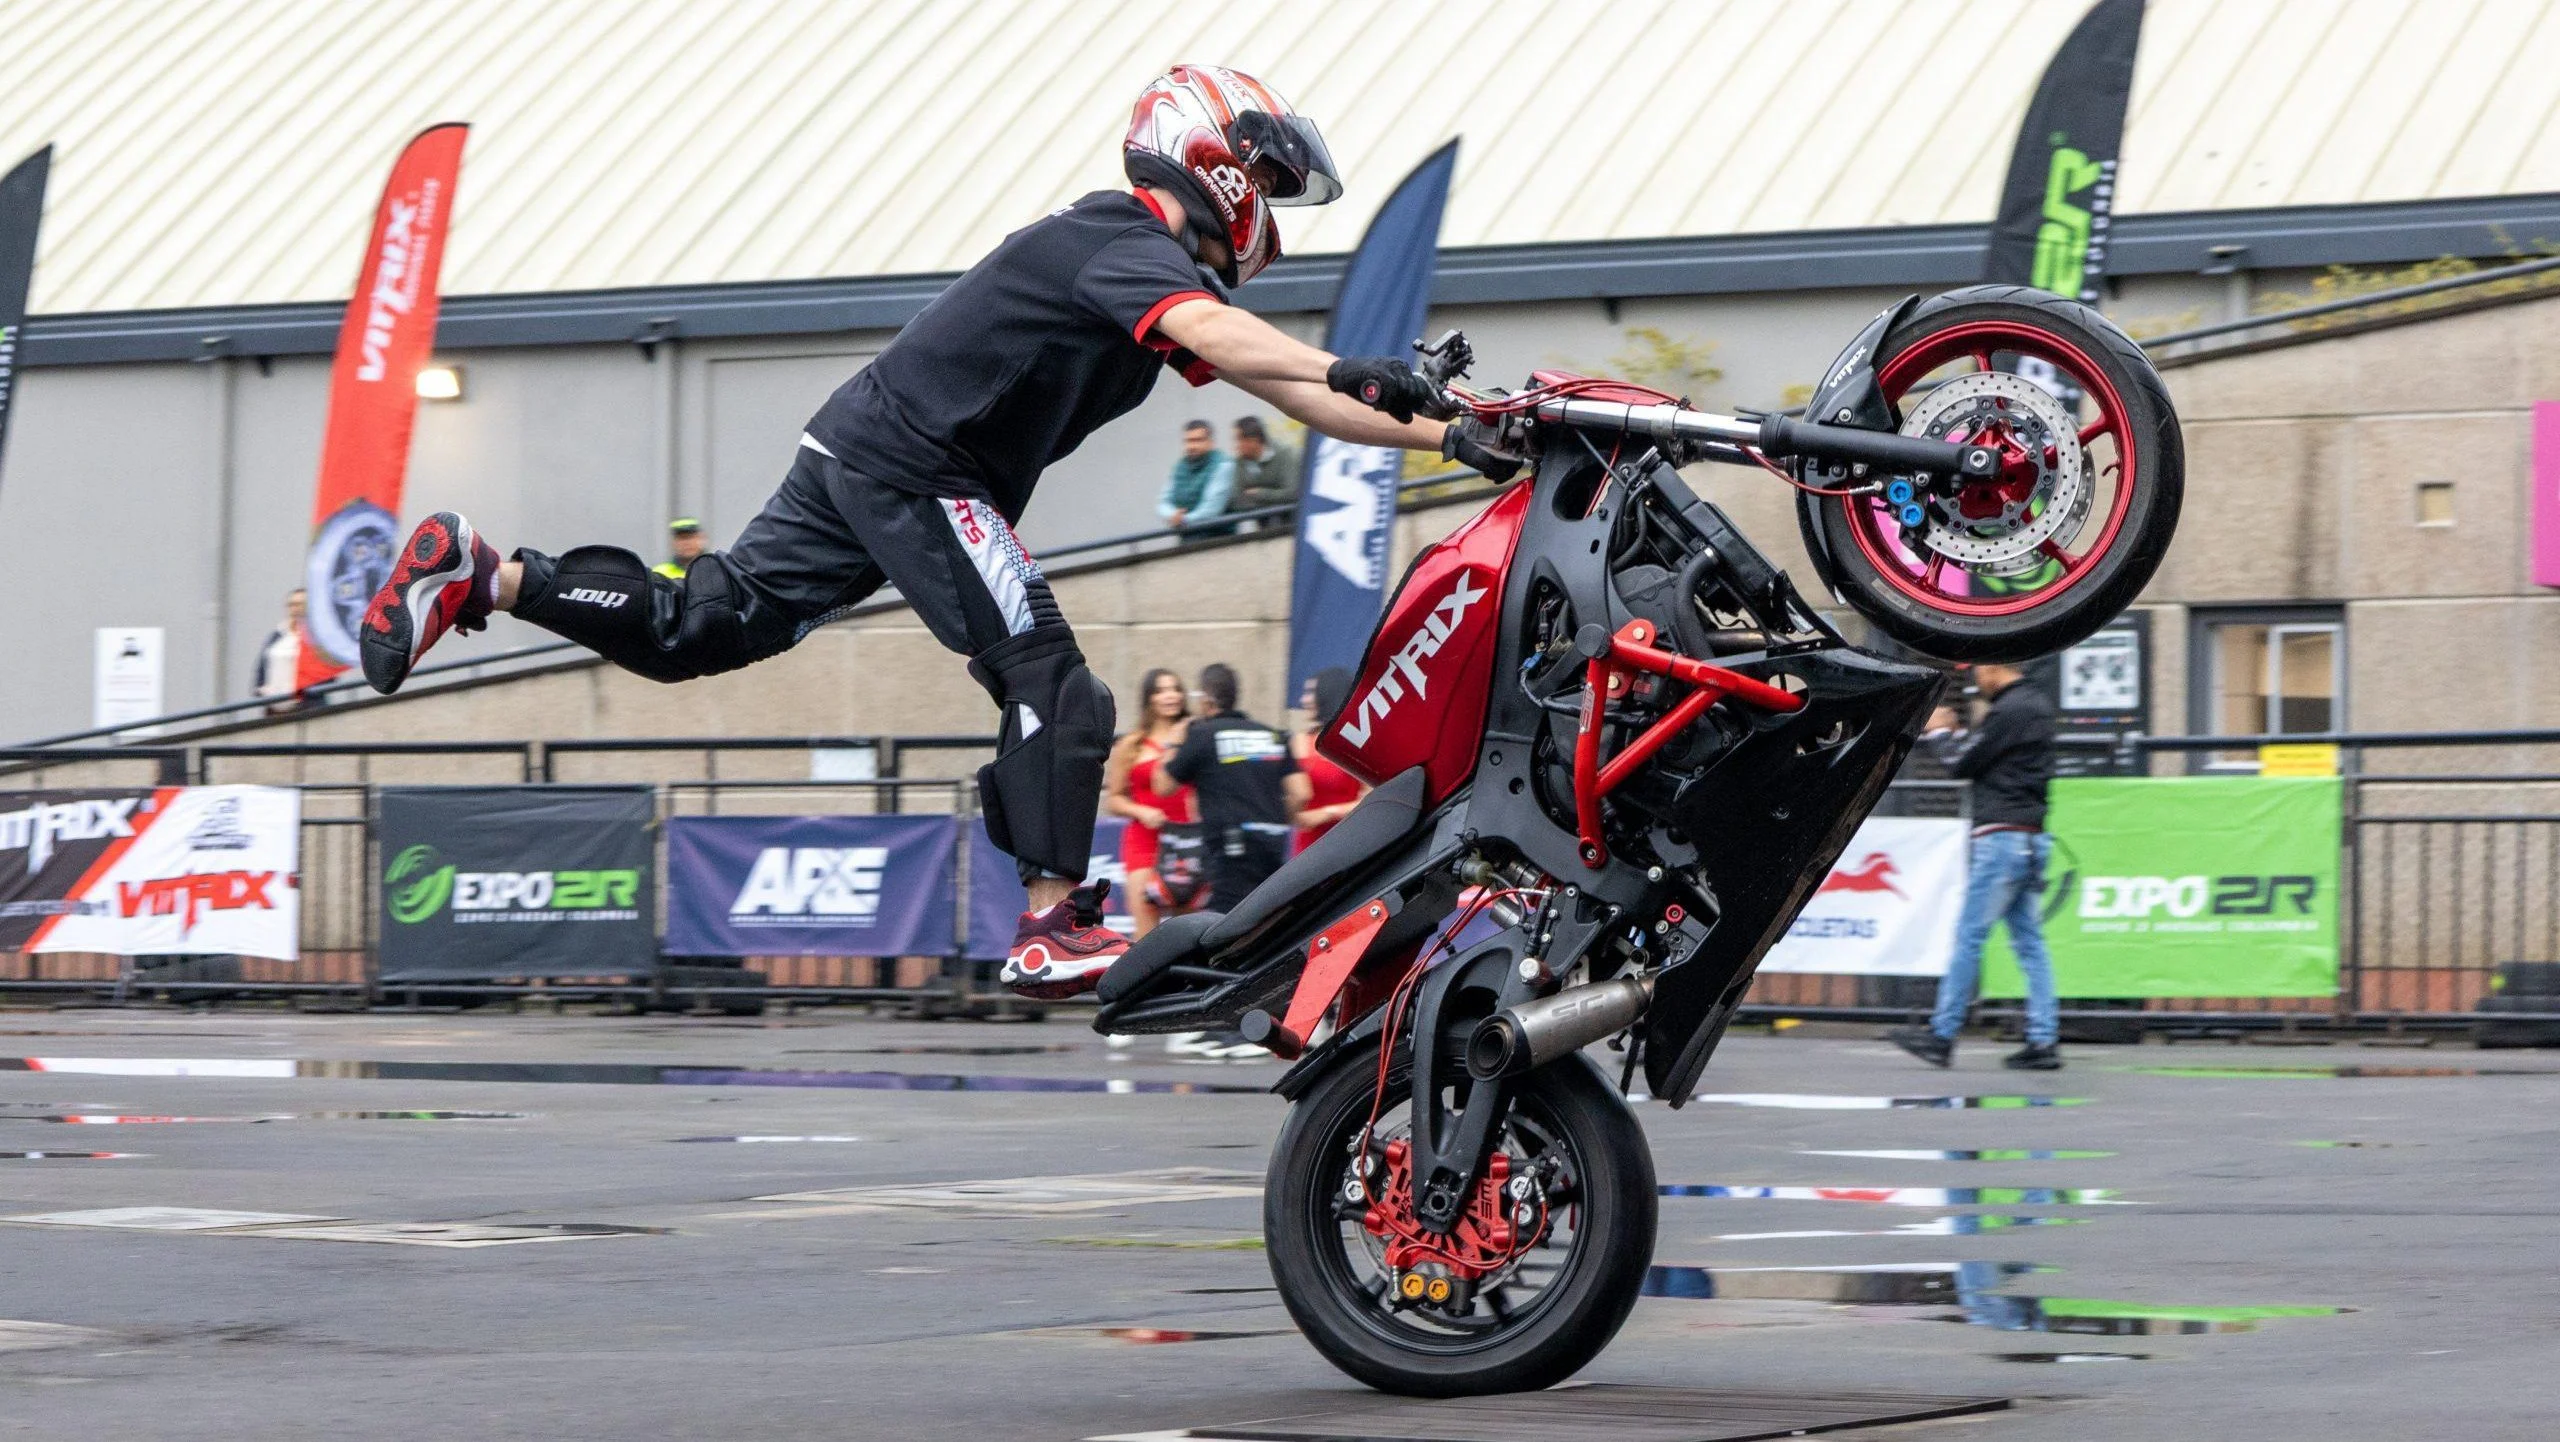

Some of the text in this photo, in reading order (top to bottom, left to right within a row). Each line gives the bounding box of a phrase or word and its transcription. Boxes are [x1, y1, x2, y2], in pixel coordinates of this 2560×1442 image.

[1194, 165, 1237, 222] OMNIPARTS
[356, 200, 418, 382] VITRIX
[1829, 345, 1867, 388] VITRIX
[558, 588, 629, 608] thor
[1339, 567, 1489, 749] VITRIX
[0, 798, 139, 878] ITRIX
[117, 870, 276, 942] VITRIX
